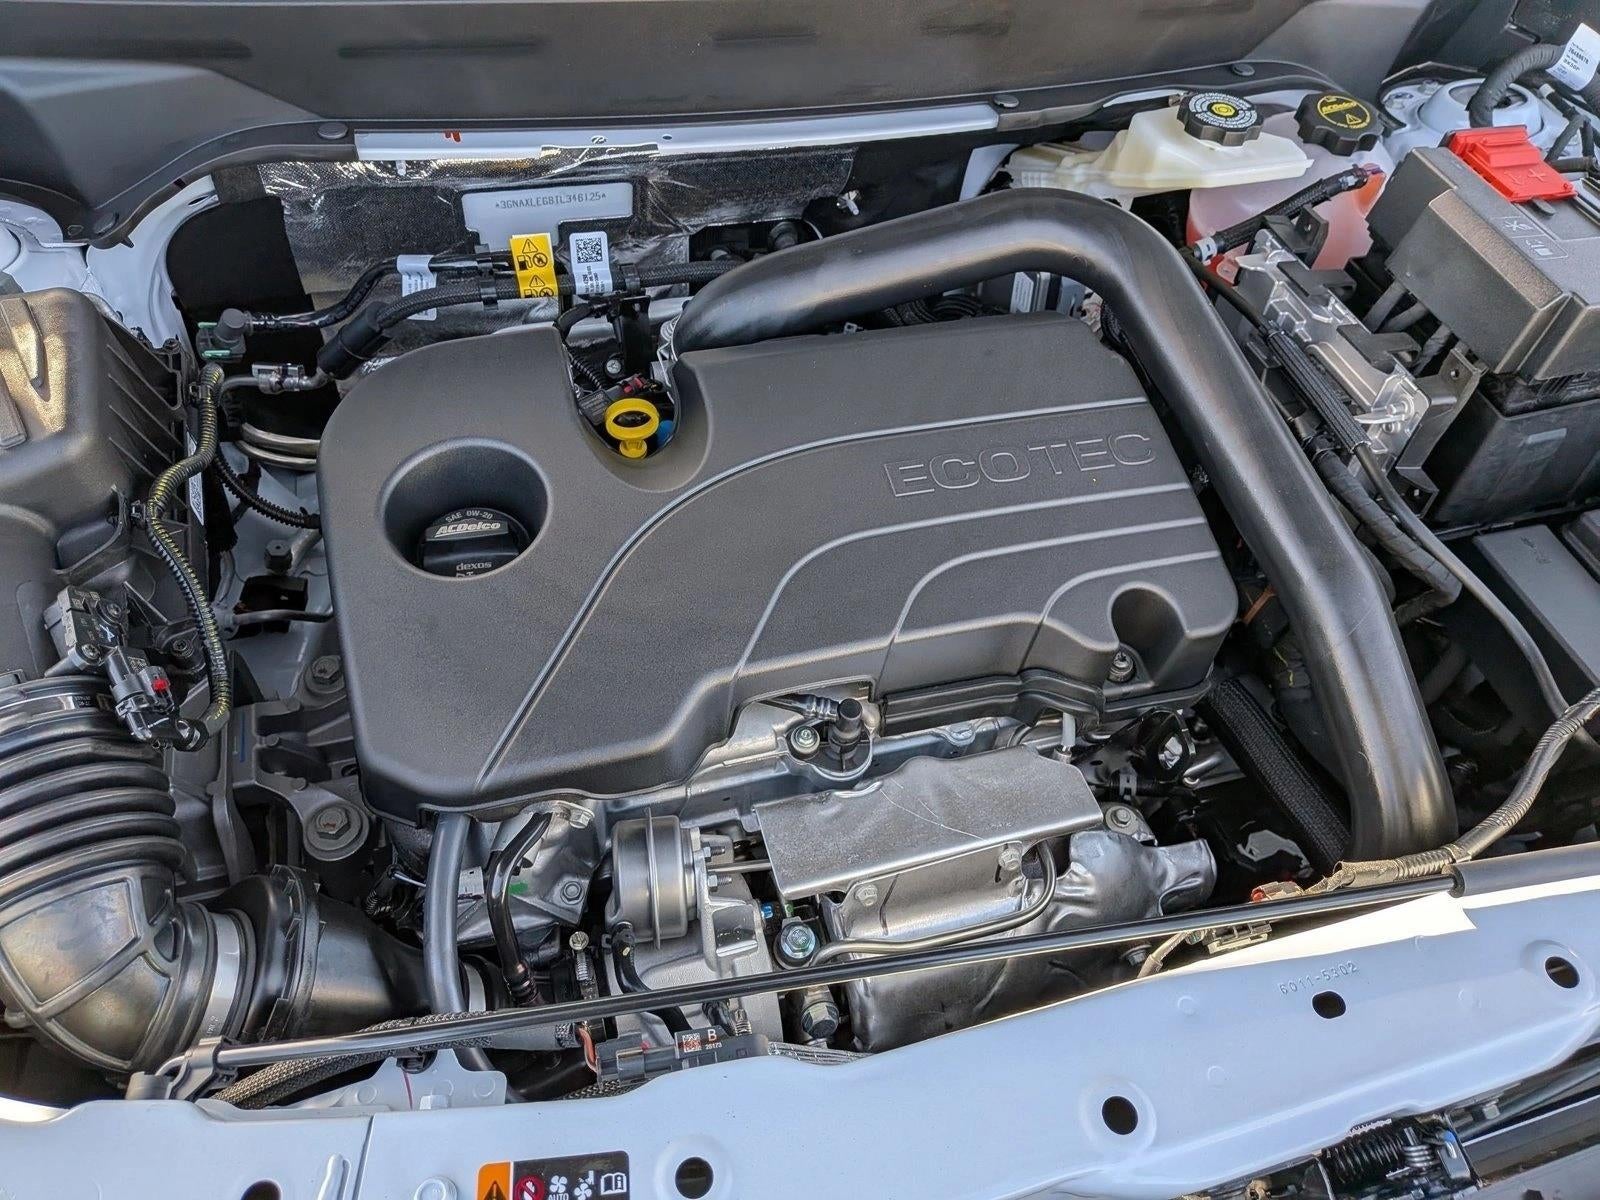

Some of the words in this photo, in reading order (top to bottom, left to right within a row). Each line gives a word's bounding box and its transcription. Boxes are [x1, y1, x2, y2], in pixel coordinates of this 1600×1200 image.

[884, 434, 1155, 497] ECOTEC
[445, 511, 463, 523] SAE
[466, 509, 493, 520] 0W-20
[435, 521, 501, 538] ACDelco
[456, 562, 492, 571] dexos
[1278, 960, 1358, 996] 6011-5302
[707, 1028, 717, 1042] B
